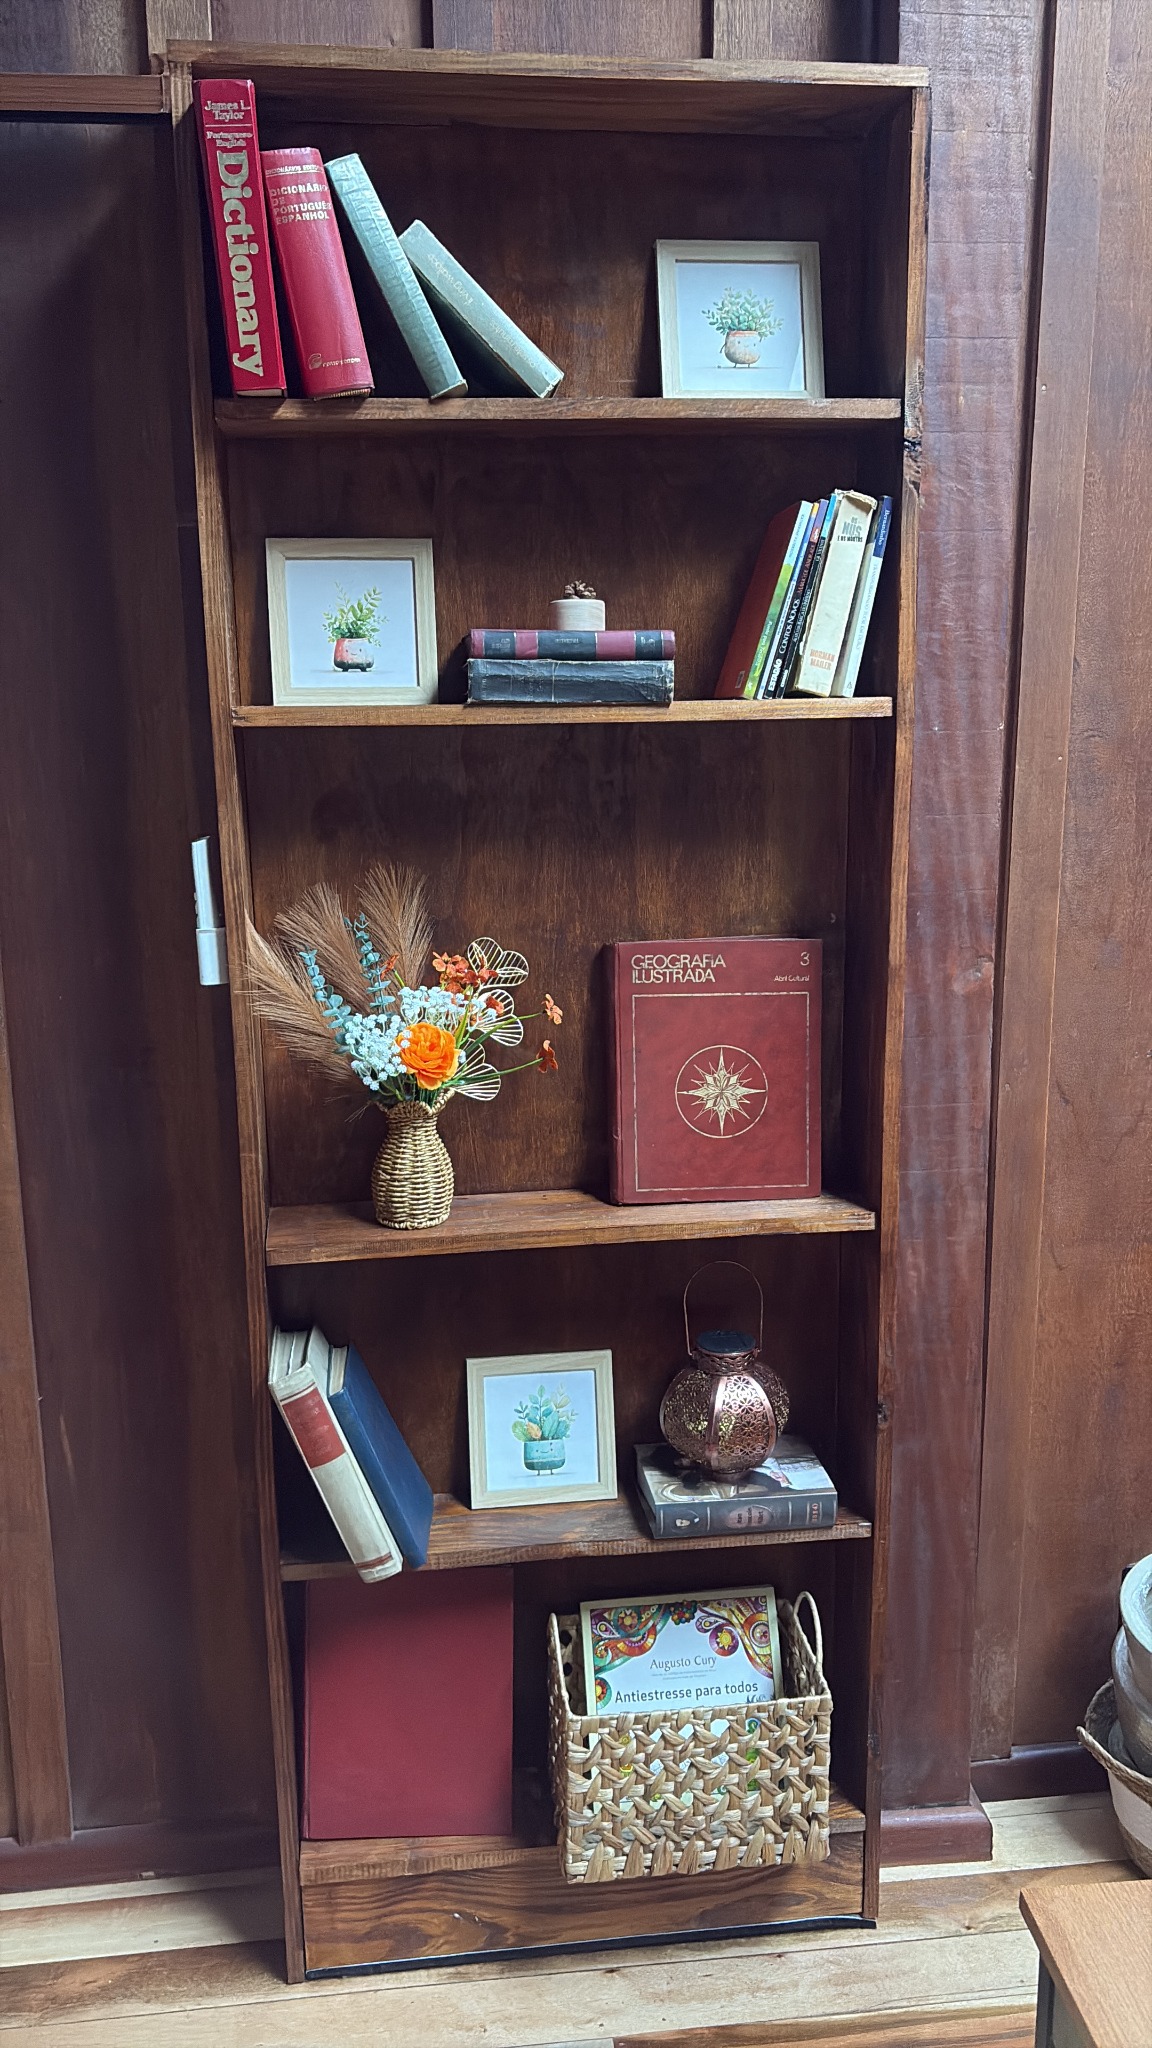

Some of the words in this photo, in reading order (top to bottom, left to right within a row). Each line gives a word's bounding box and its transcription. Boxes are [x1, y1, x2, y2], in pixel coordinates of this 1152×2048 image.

[205, 100, 239, 110] James
[212, 110, 245, 122] Taylor
[216, 139, 246, 148] English
[271, 183, 329, 197] DICIONÁRIO
[271, 197, 286, 207] DE
[273, 201, 332, 216] PORTUGUÊS
[275, 210, 330, 225] ESPANHOL
[217, 150, 264, 377] Dictionary
[842, 521, 862, 537] NUS
[768, 658, 782, 691] ESTADÃO
[779, 624, 793, 654] CONTOS
[788, 598, 800, 626] NOVOS
[810, 649, 835, 662] NORMAN
[810, 657, 831, 670] MAILER
[631, 953, 726, 969] GEOGRAFIA
[800, 951, 810, 966] 3
[632, 968, 716, 984] ILUSTRADA
[788, 974, 810, 982] Cultural
[650, 1657, 691, 1672] Augusto
[694, 1655, 717, 1669] Cury
[615, 1688, 692, 1704] Antiestresse
[695, 1686, 722, 1700] para
[724, 1681, 758, 1694] todos
